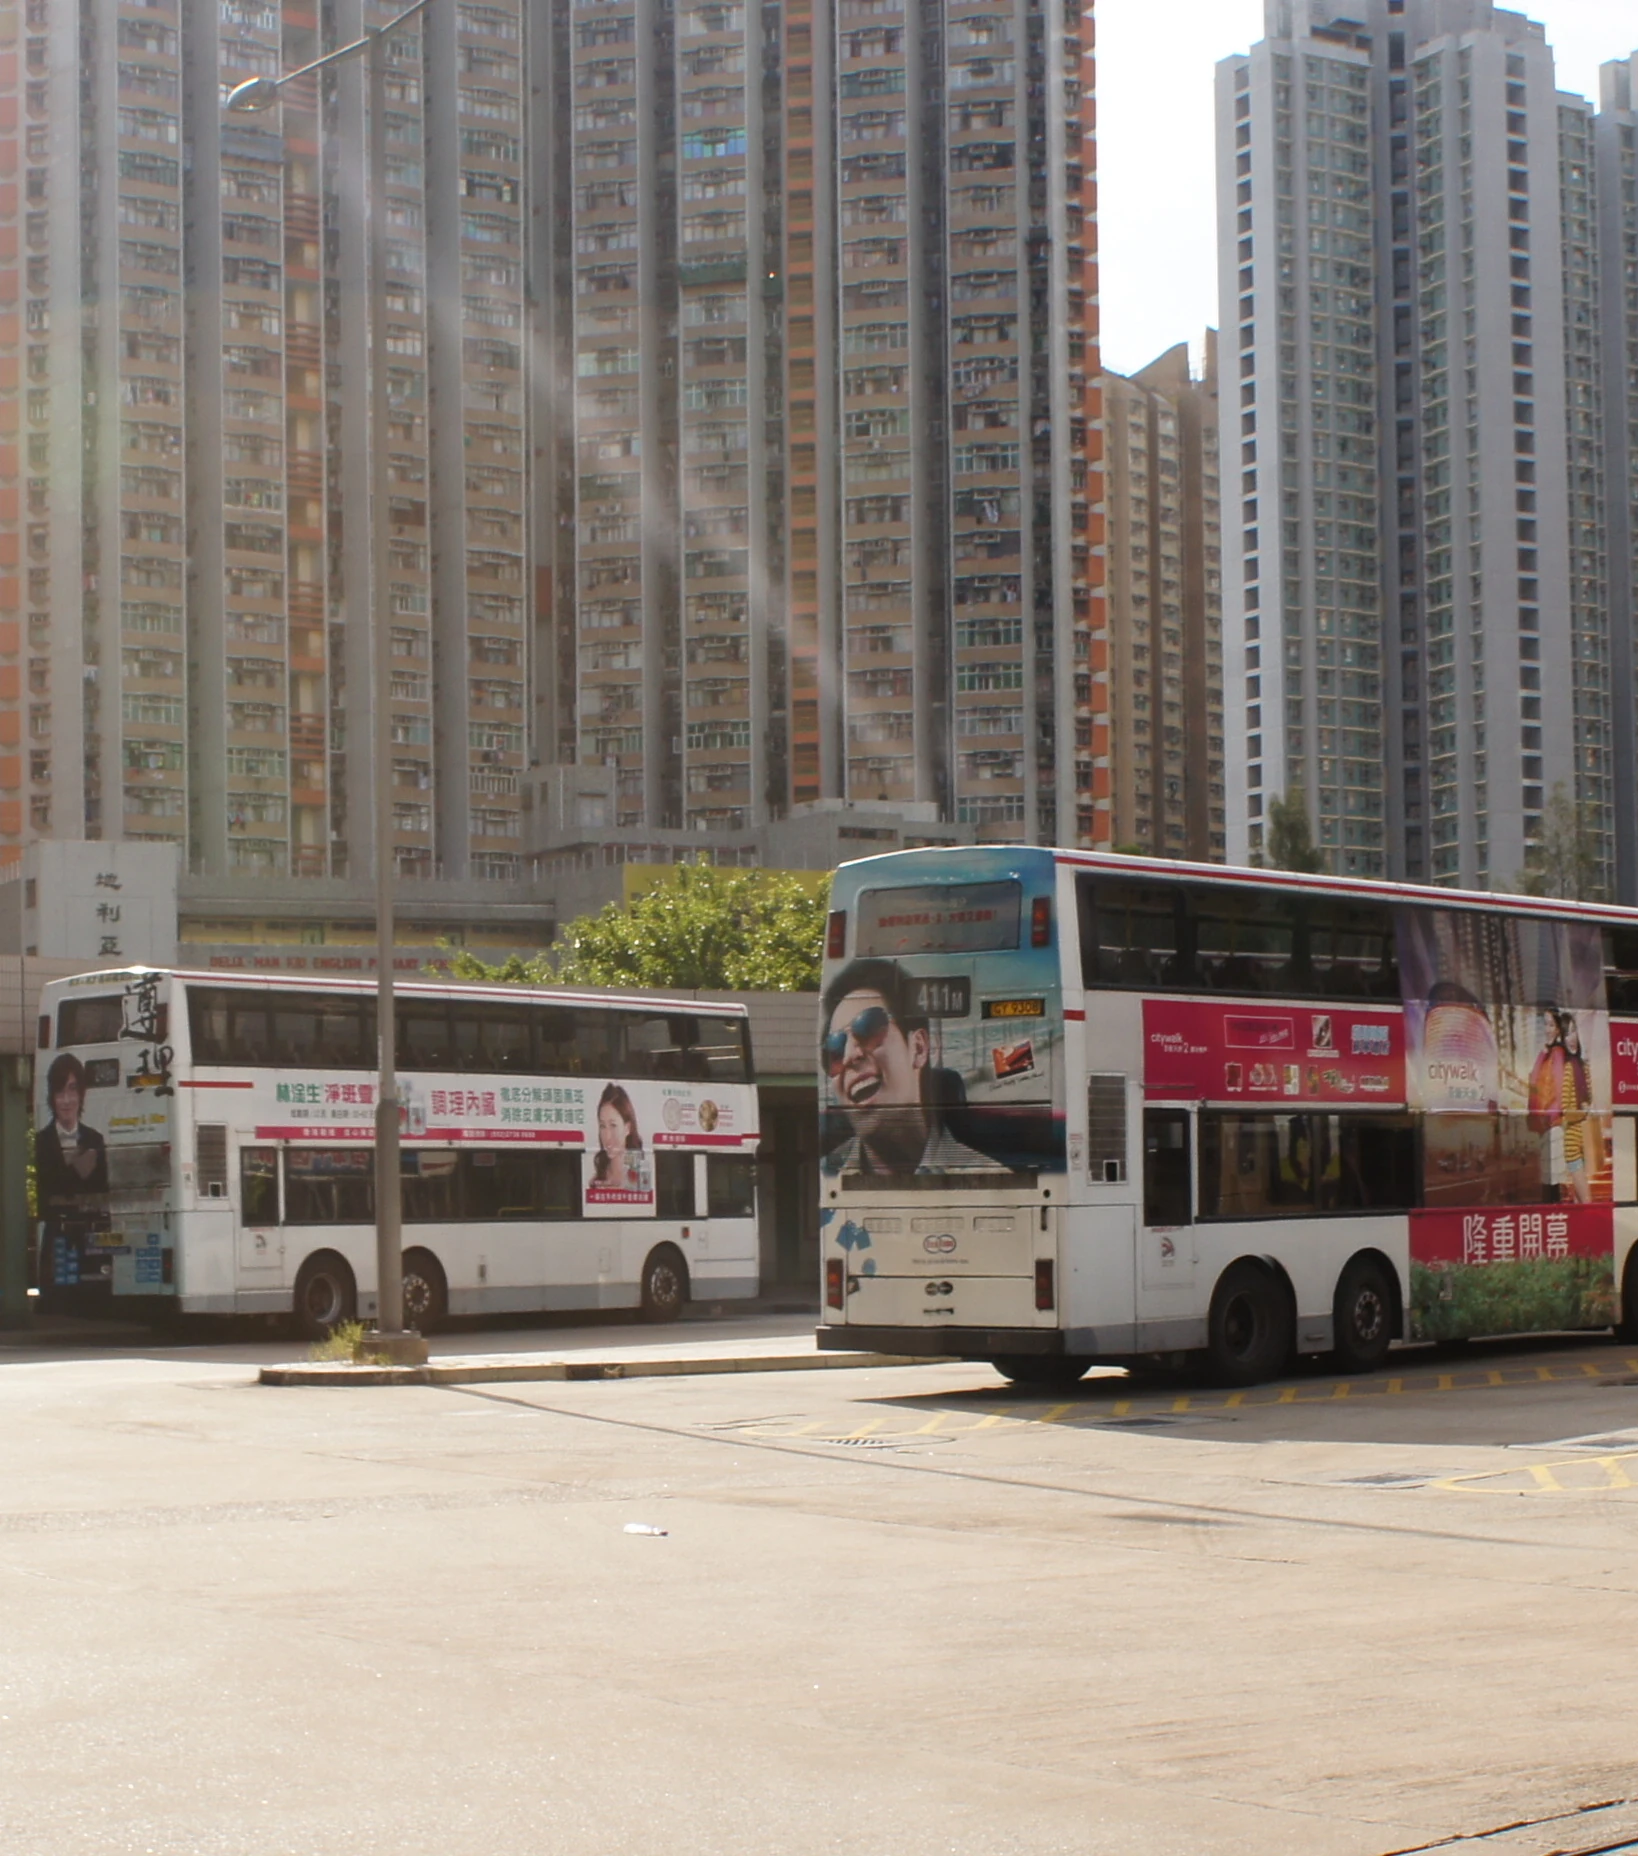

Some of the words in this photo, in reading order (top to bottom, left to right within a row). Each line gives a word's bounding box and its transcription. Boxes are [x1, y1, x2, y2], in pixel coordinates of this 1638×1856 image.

[917, 983, 964, 1012] 411M
[1428, 1060, 1479, 1084] citywalk
[1462, 1213, 1570, 1265] 隆重開幕
